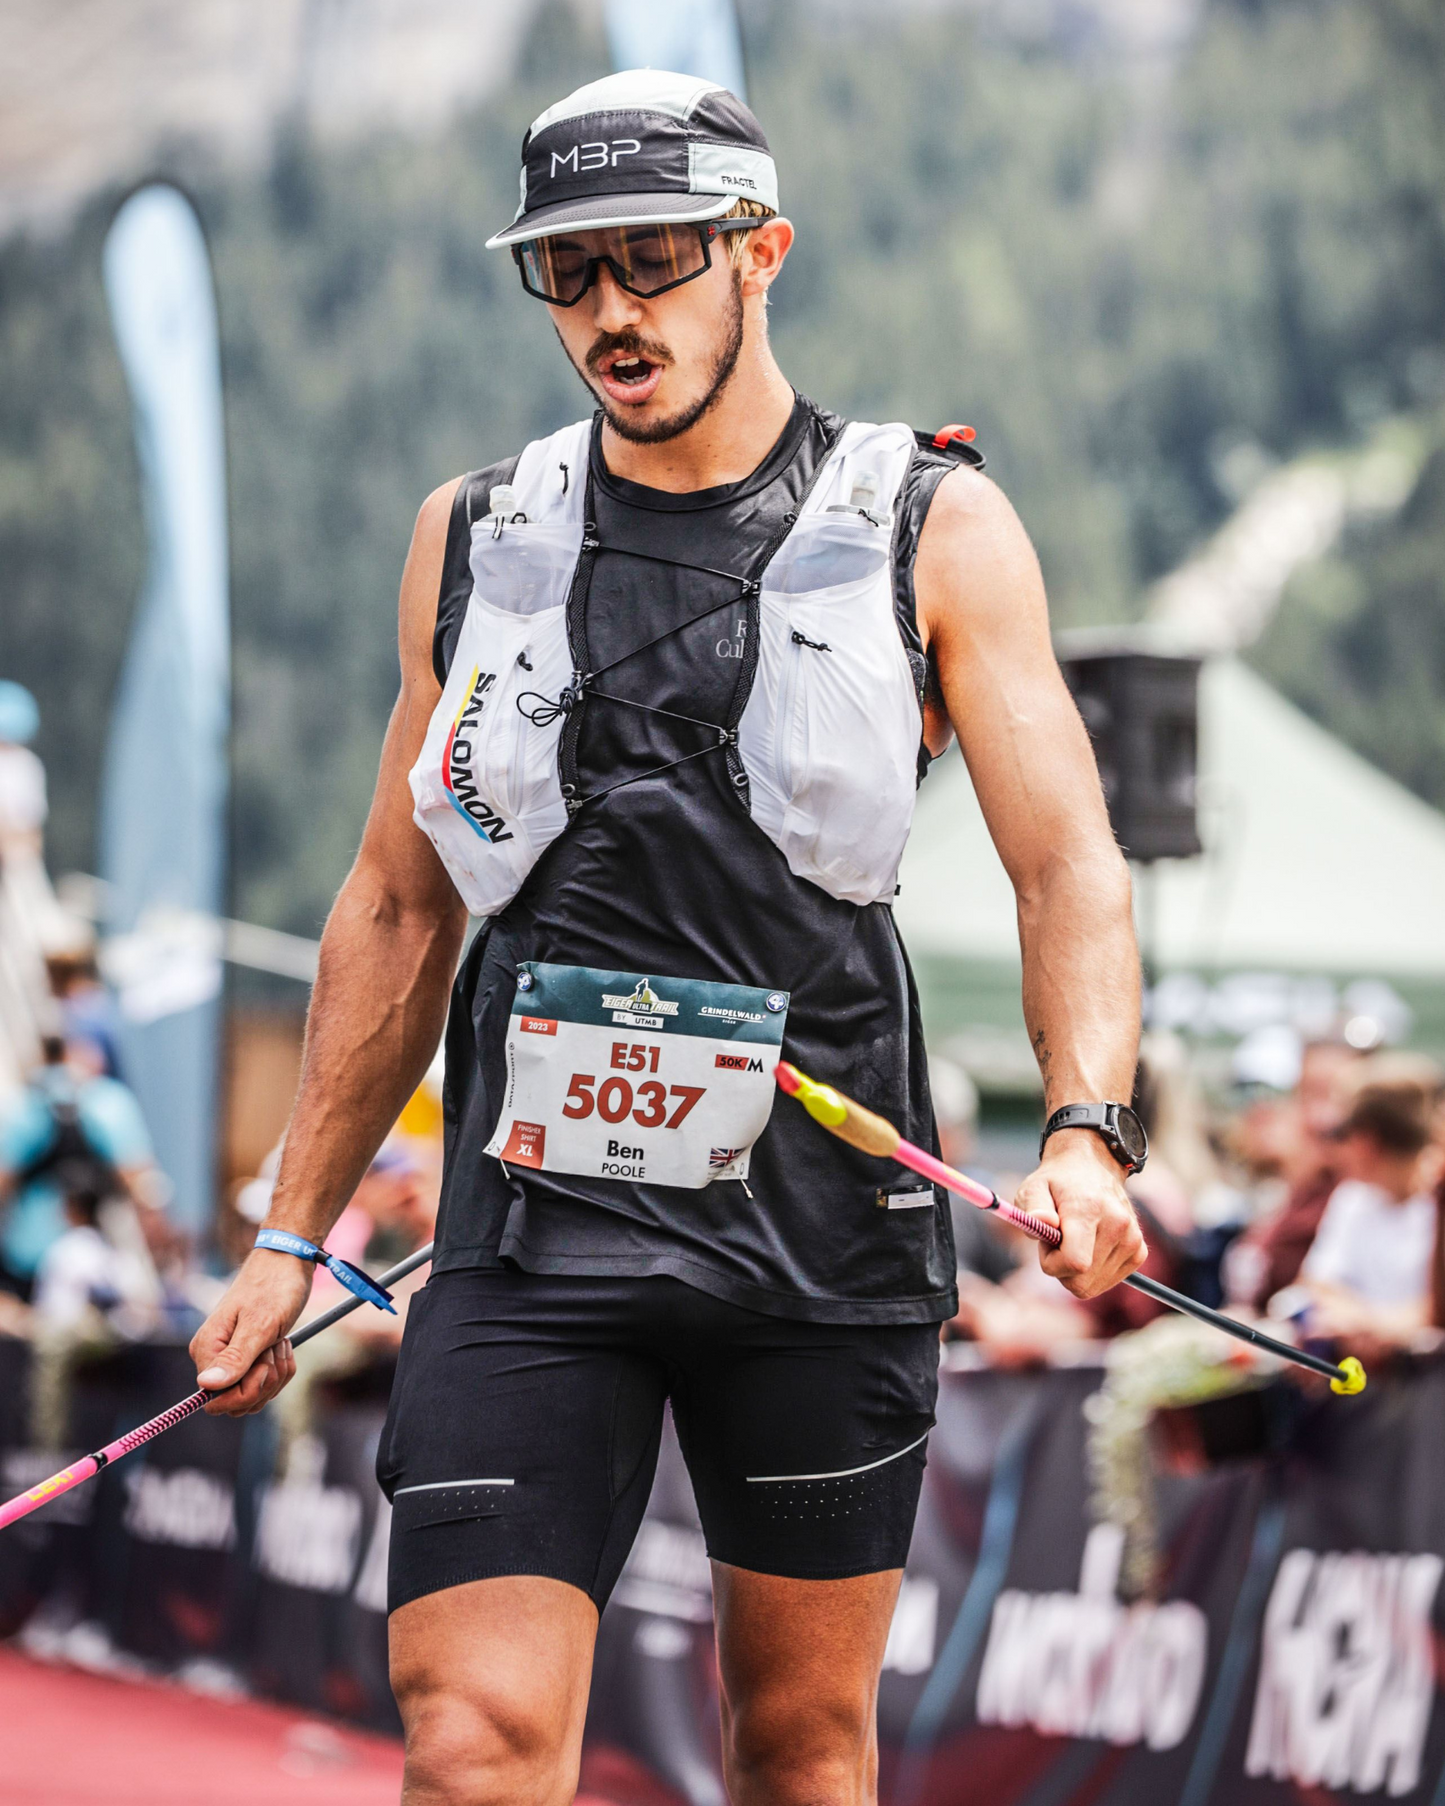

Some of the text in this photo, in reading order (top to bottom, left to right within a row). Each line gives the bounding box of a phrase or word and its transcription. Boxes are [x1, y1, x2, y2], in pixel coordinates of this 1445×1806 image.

[721, 175, 757, 190] FRACTEL
[450, 672, 514, 844] SALOMON
[605, 997, 678, 1013] EIGER ULTRA TRAIL
[617, 1013, 657, 1026] BY UTMB
[701, 1006, 761, 1021] GRINDELWALD
[527, 1021, 549, 1032] 2023
[610, 1042, 661, 1073] E51
[719, 1056, 764, 1073] 50K M
[562, 1073, 707, 1130] 5037
[517, 1124, 541, 1135] FINISHER
[520, 1133, 537, 1142] SHIRT
[516, 1143, 534, 1157] XL
[606, 1139, 644, 1161] Ben
[601, 1162, 646, 1179] POOLE
[271, 1235, 302, 1251] EIGER
[329, 1261, 353, 1285] TRAIL
[26, 1471, 75, 1502] LEKI
